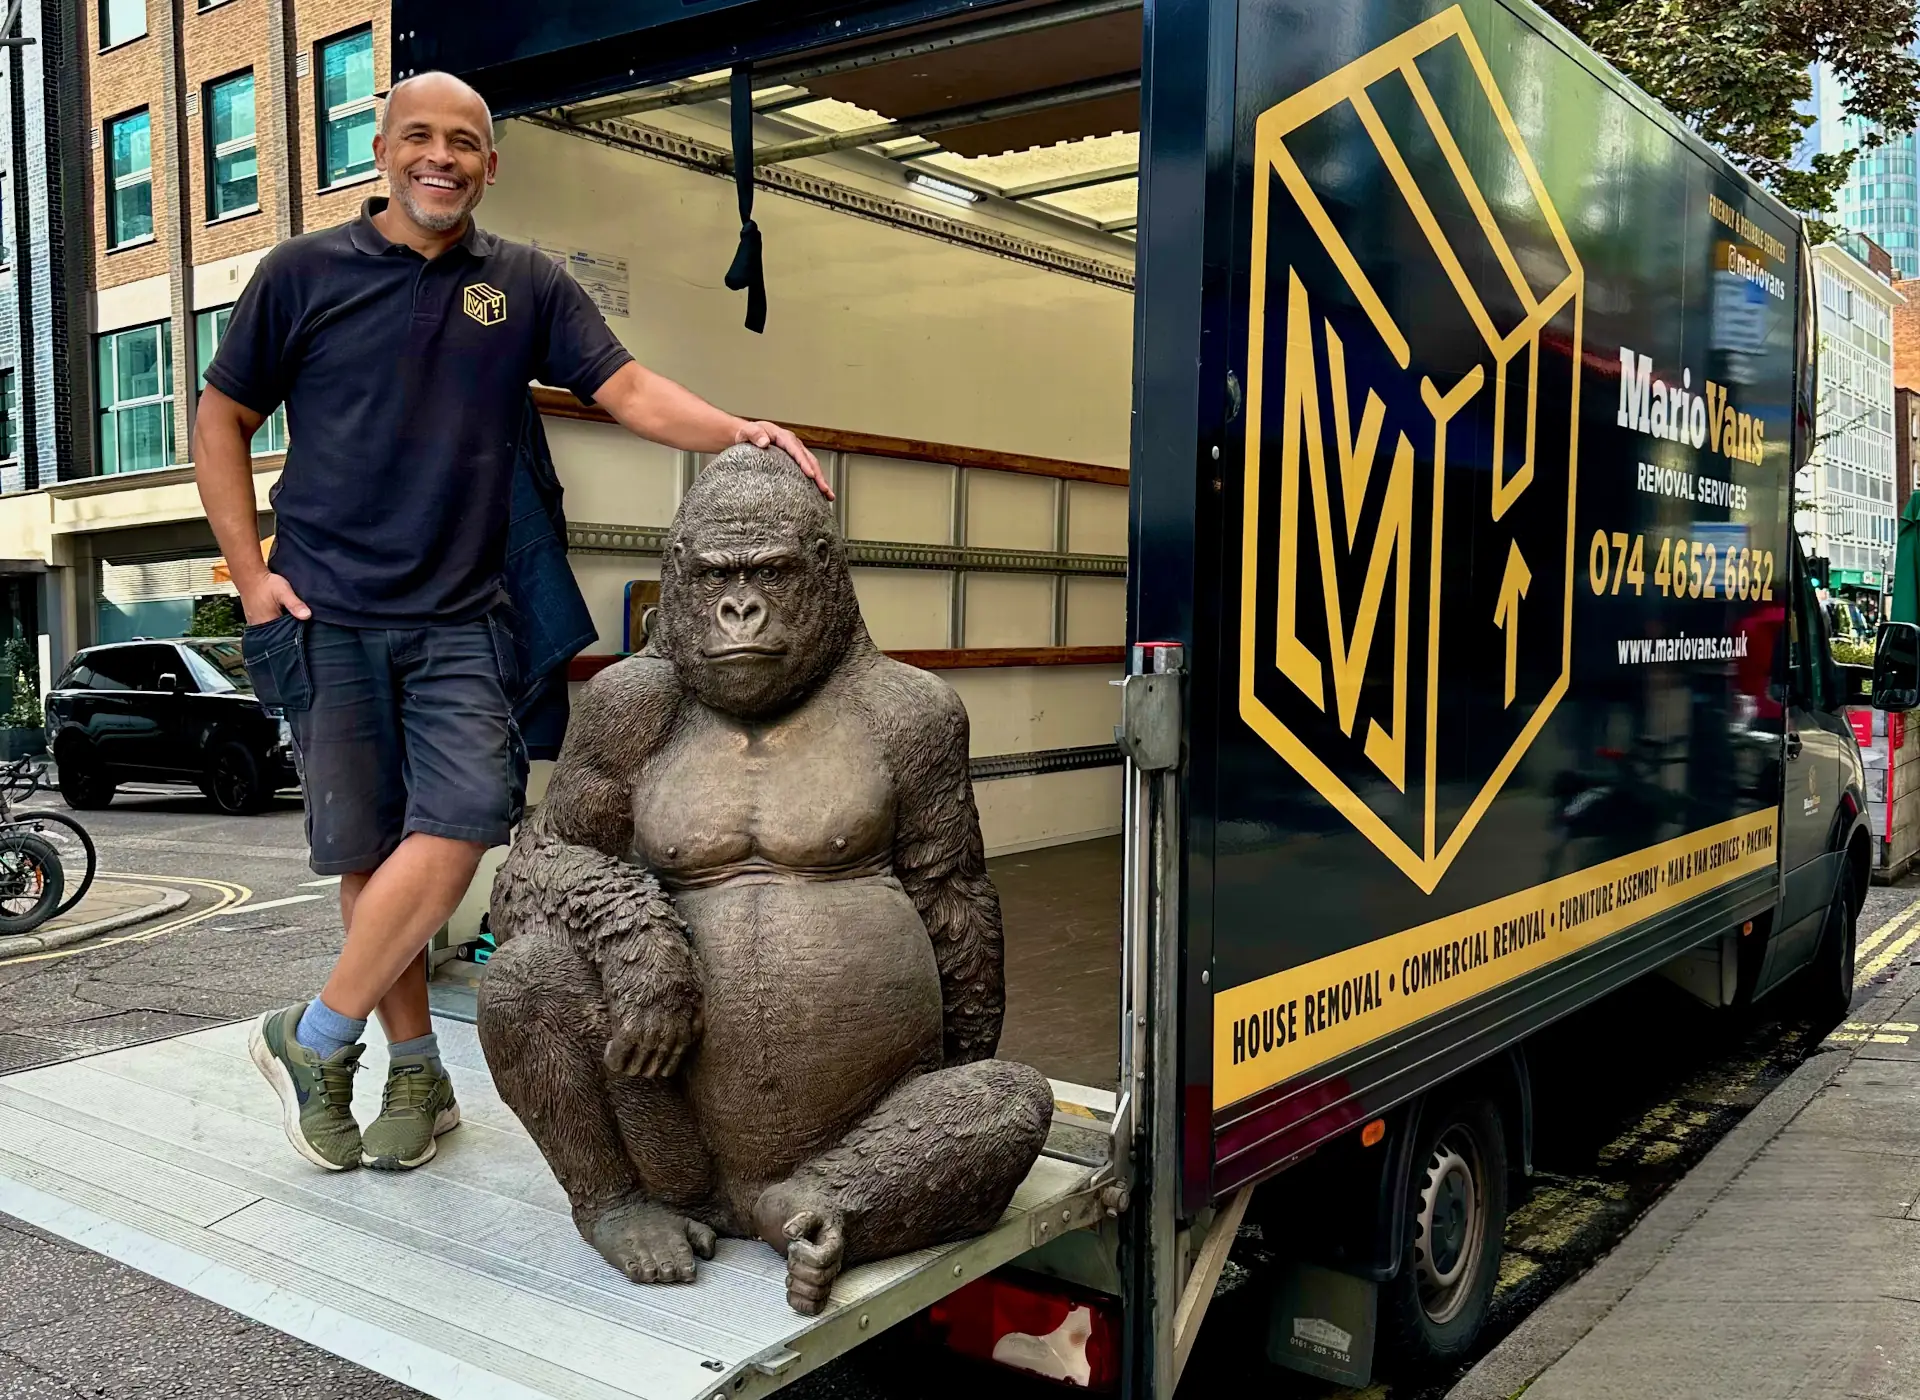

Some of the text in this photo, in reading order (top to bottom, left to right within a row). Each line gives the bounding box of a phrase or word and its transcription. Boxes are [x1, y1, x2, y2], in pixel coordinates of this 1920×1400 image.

[1637, 462, 1747, 510] REMOVAL SERVICES
[1589, 530, 1773, 601] 074 4652 6632
[1617, 630, 1748, 665] www.mariovans.co.uk
[1232, 824, 1772, 1065] HOUSE REMOVAL COMMERCIAL REMOVAL FURNITURE ASSEMBLY MAN & VAN SERVICES PACKING
[1291, 1337, 1306, 1348] 0161
